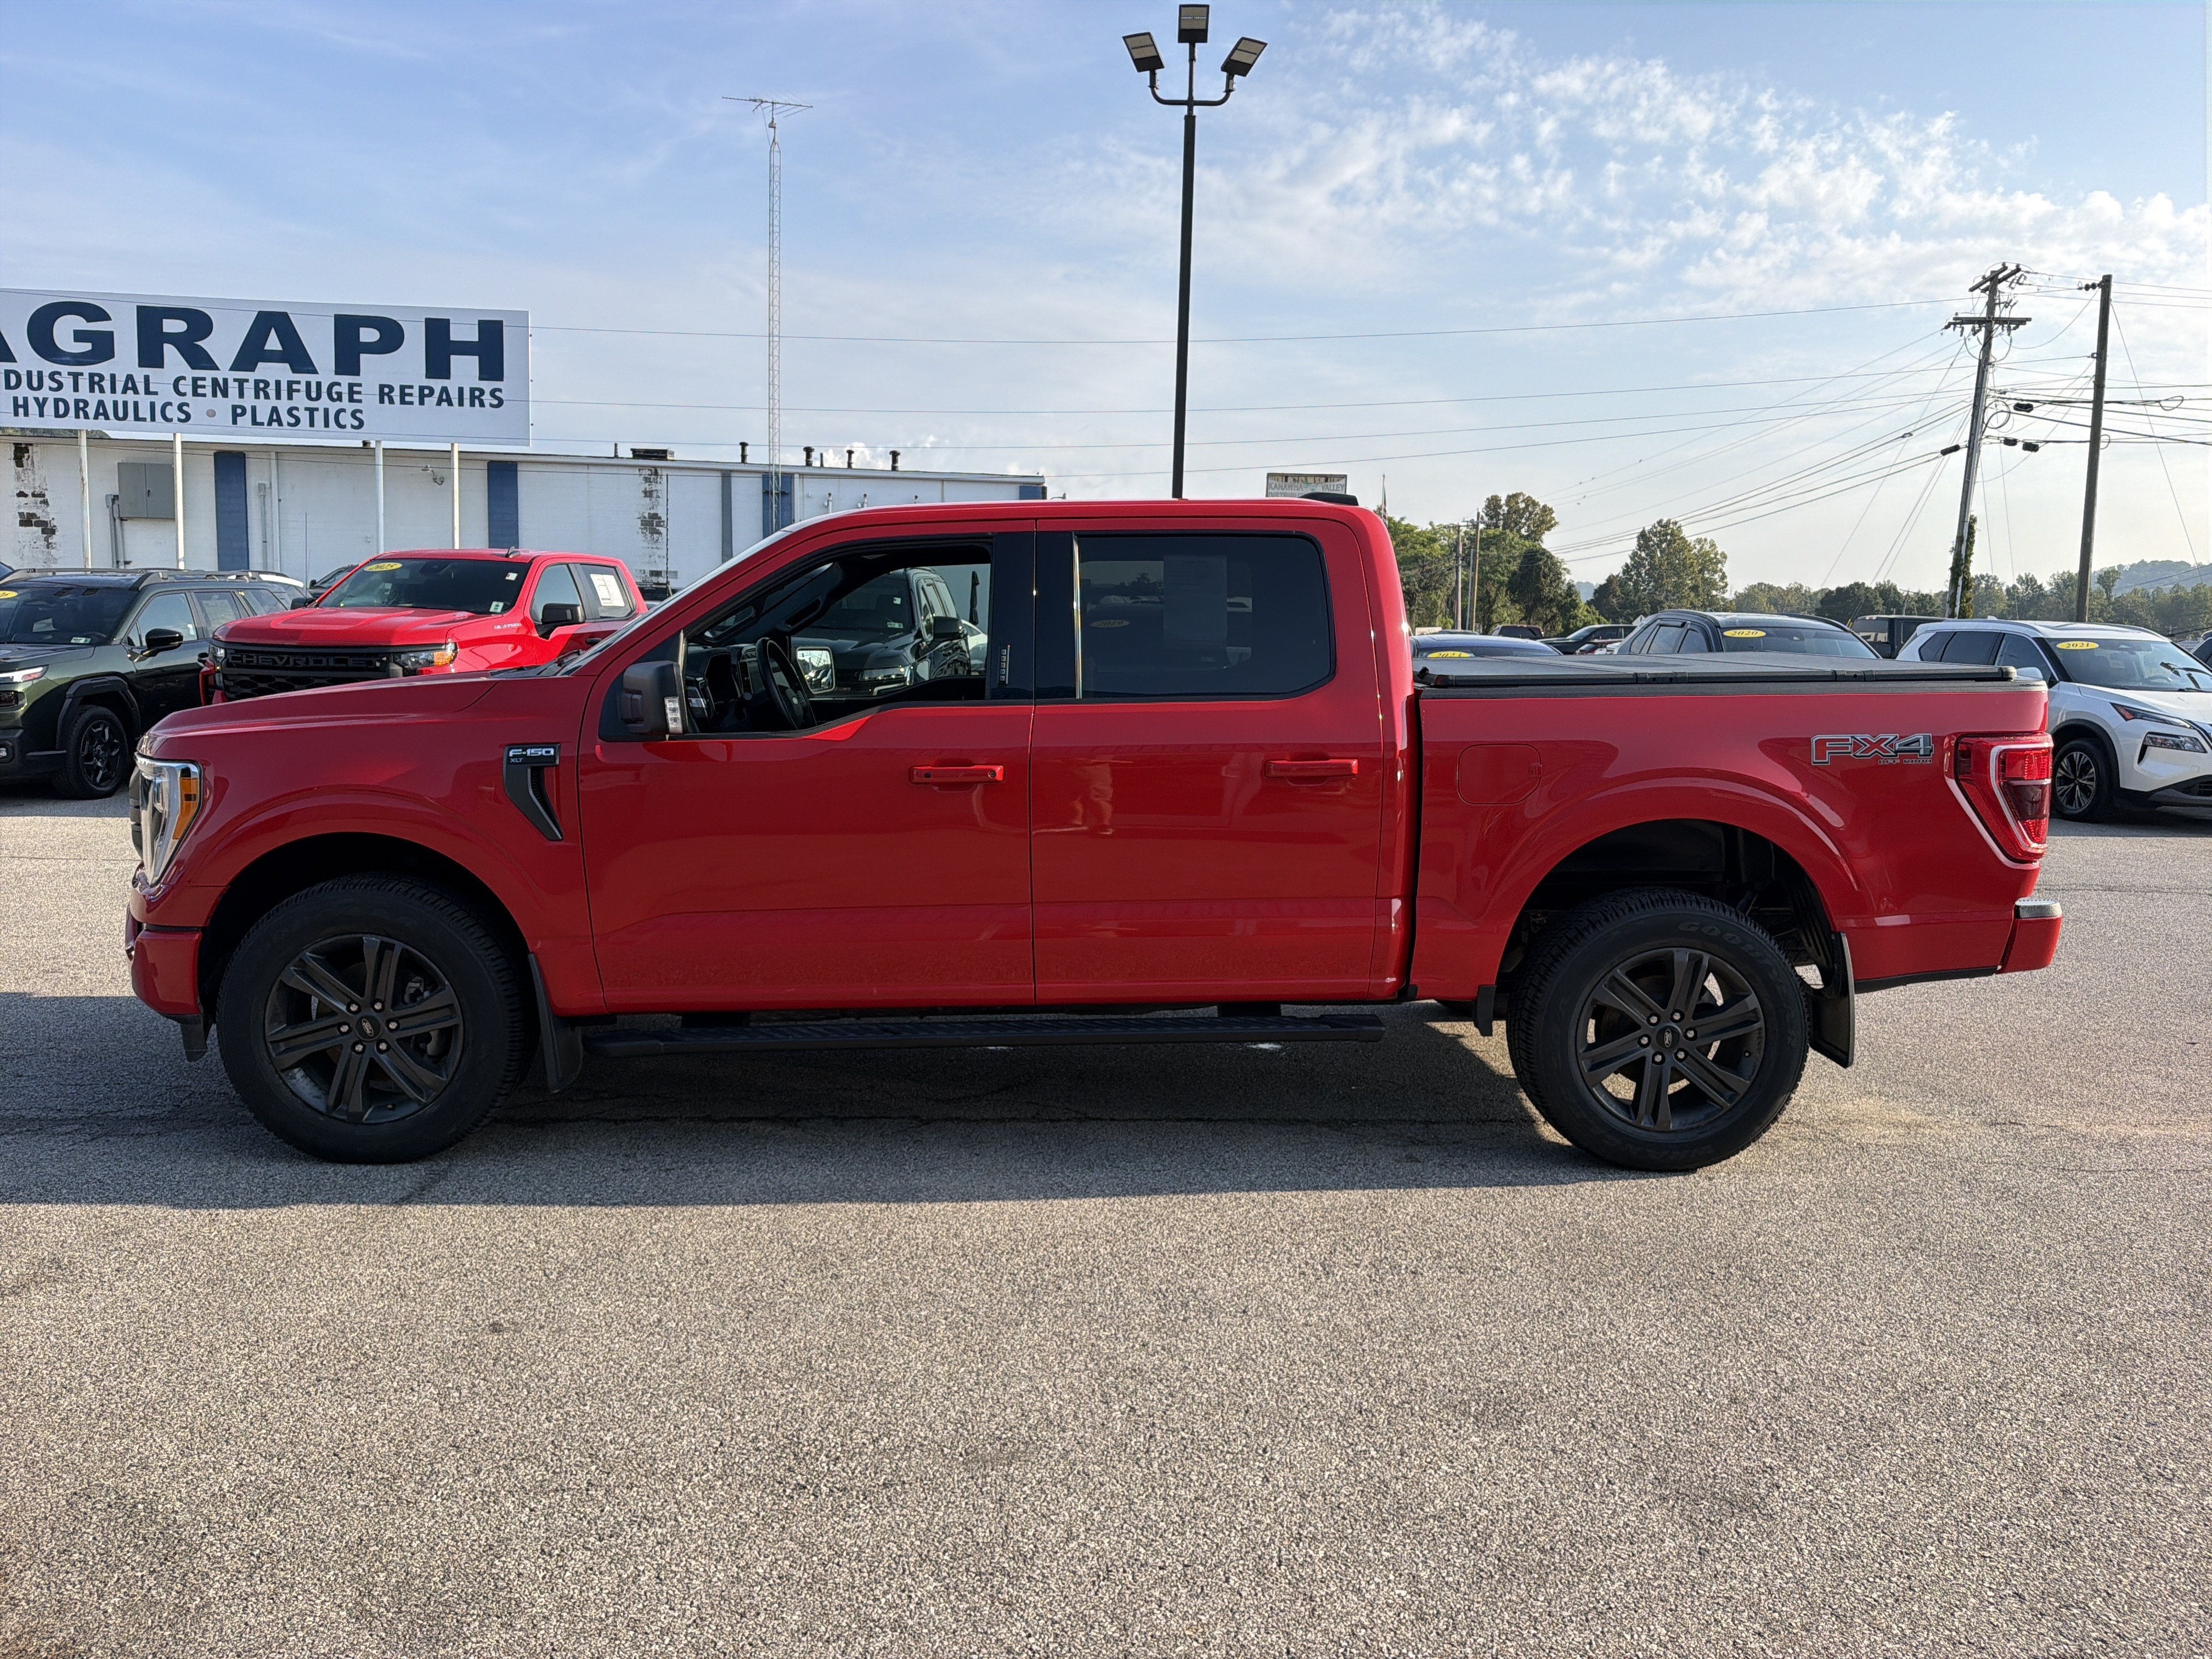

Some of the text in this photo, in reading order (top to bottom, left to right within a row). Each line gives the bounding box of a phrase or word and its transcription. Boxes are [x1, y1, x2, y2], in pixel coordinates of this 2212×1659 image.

[0, 301, 504, 382] GRAPH
[4, 369, 504, 409] DUSTRIAL CENTRIFUGE REPAIRS
[12, 396, 364, 430] HYDRAULICS PLASTICS
[1268, 482, 1345, 492] KANAWHA VALLEY
[227, 654, 378, 668] CHEVROLET
[509, 748, 554, 757] F-150
[1811, 733, 1934, 765] FX4
